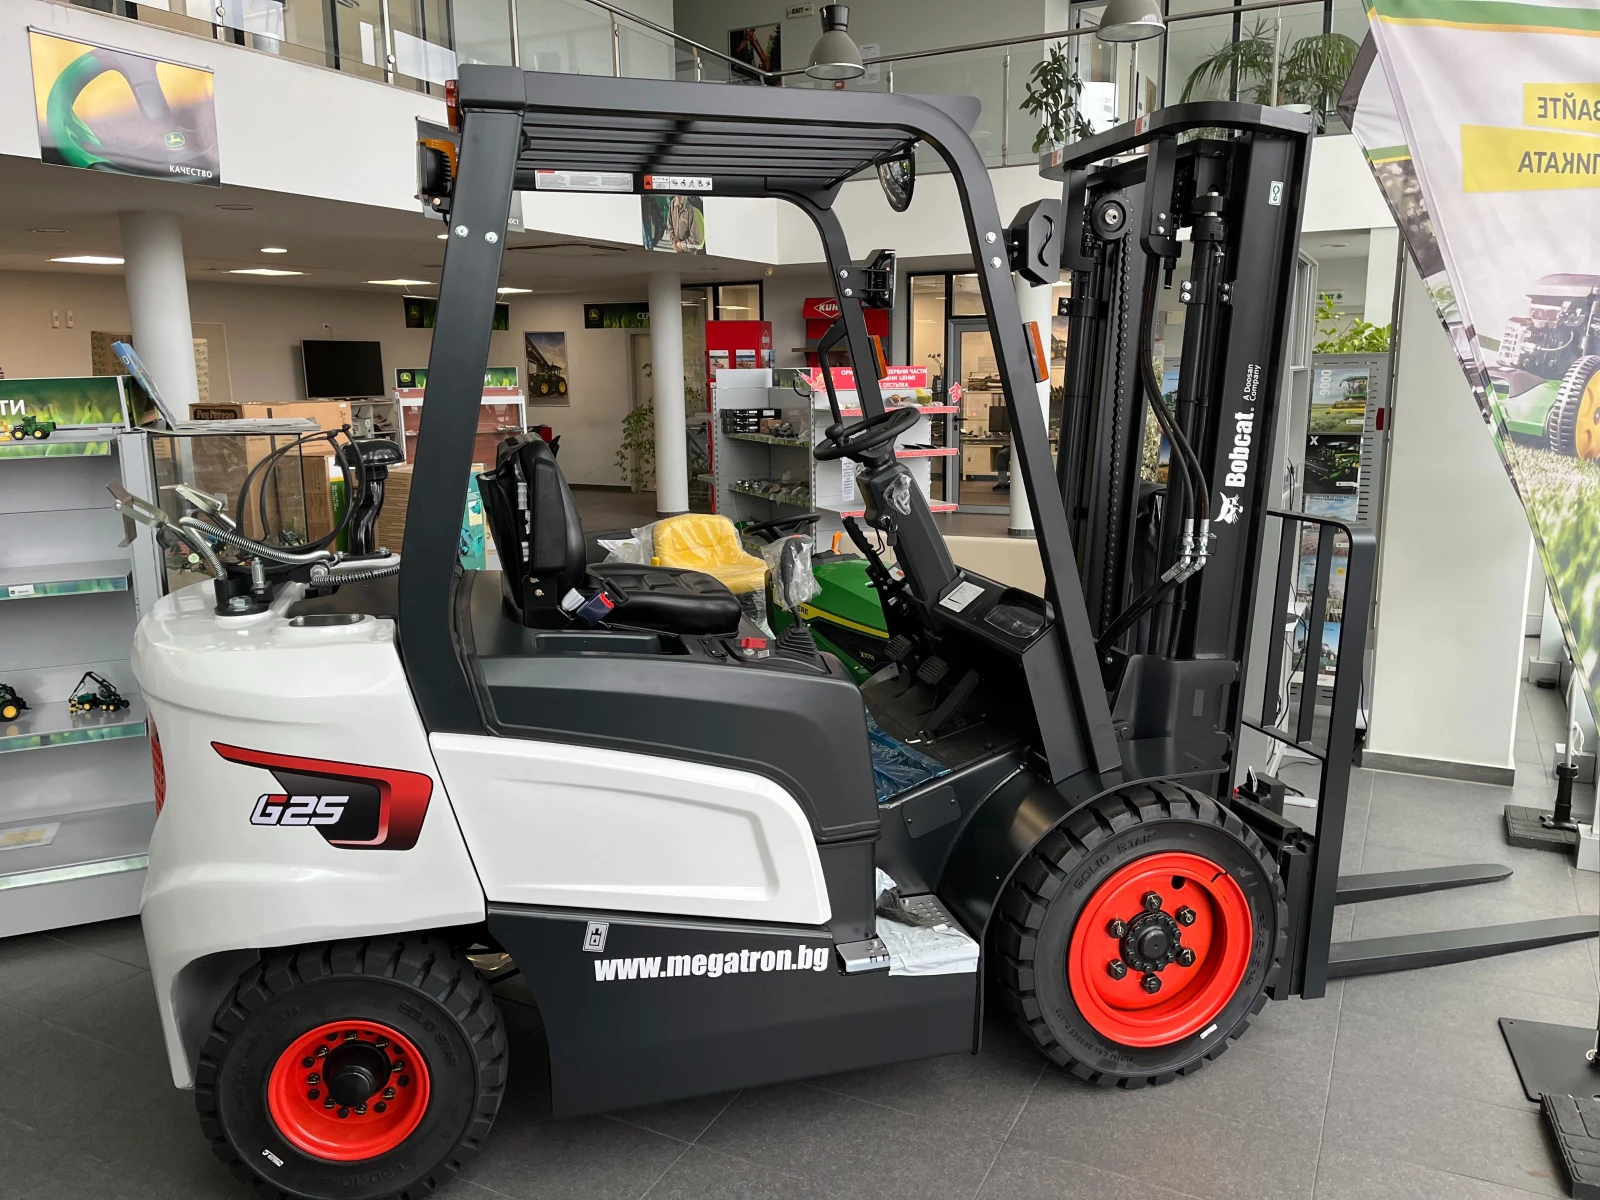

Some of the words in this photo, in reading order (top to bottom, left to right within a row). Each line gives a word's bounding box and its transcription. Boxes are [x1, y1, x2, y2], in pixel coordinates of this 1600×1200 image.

[169, 164, 213, 179] КАЧЕСТВО
[1244, 363, 1254, 393] Doosan
[1250, 364, 1261, 402] Company
[1319, 369, 1332, 396] 9000
[1224, 411, 1254, 488] Bobcat
[1309, 435, 1319, 446] X
[250, 794, 350, 826] G25
[1073, 853, 1110, 890] SOLID
[594, 944, 829, 981] www.megatron.bg
